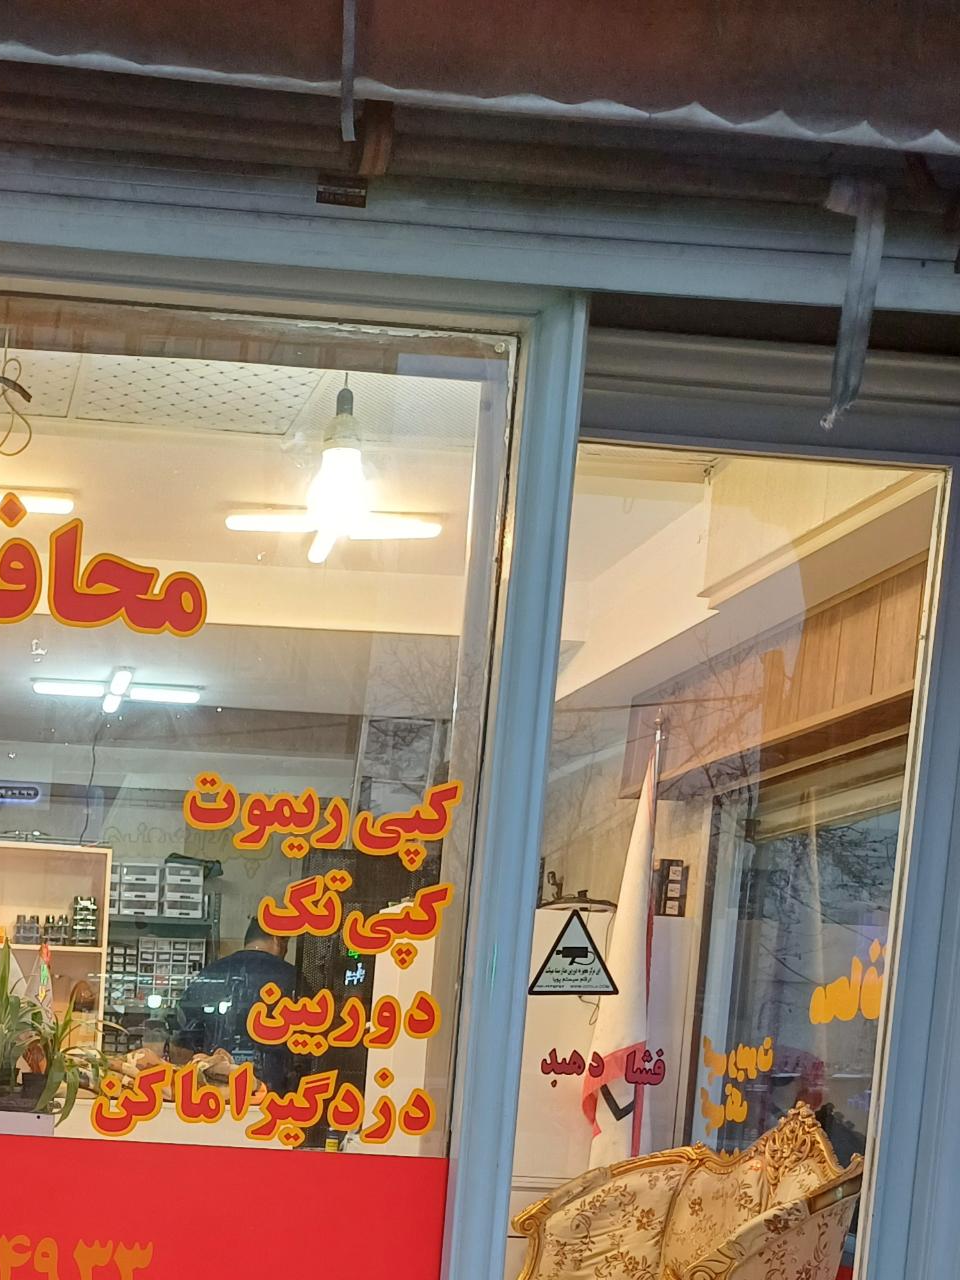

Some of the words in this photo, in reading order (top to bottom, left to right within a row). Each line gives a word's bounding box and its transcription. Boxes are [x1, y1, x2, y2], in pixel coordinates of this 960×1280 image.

[184, 771, 350, 857] ریموت
[354, 779, 463, 871] کپی
[257, 869, 352, 936] تگ
[343, 883, 454, 969] کپی
[247, 982, 441, 1056] دوربین
[91, 1062, 255, 1137] اماکن
[246, 1068, 437, 1147] دزدگیر
